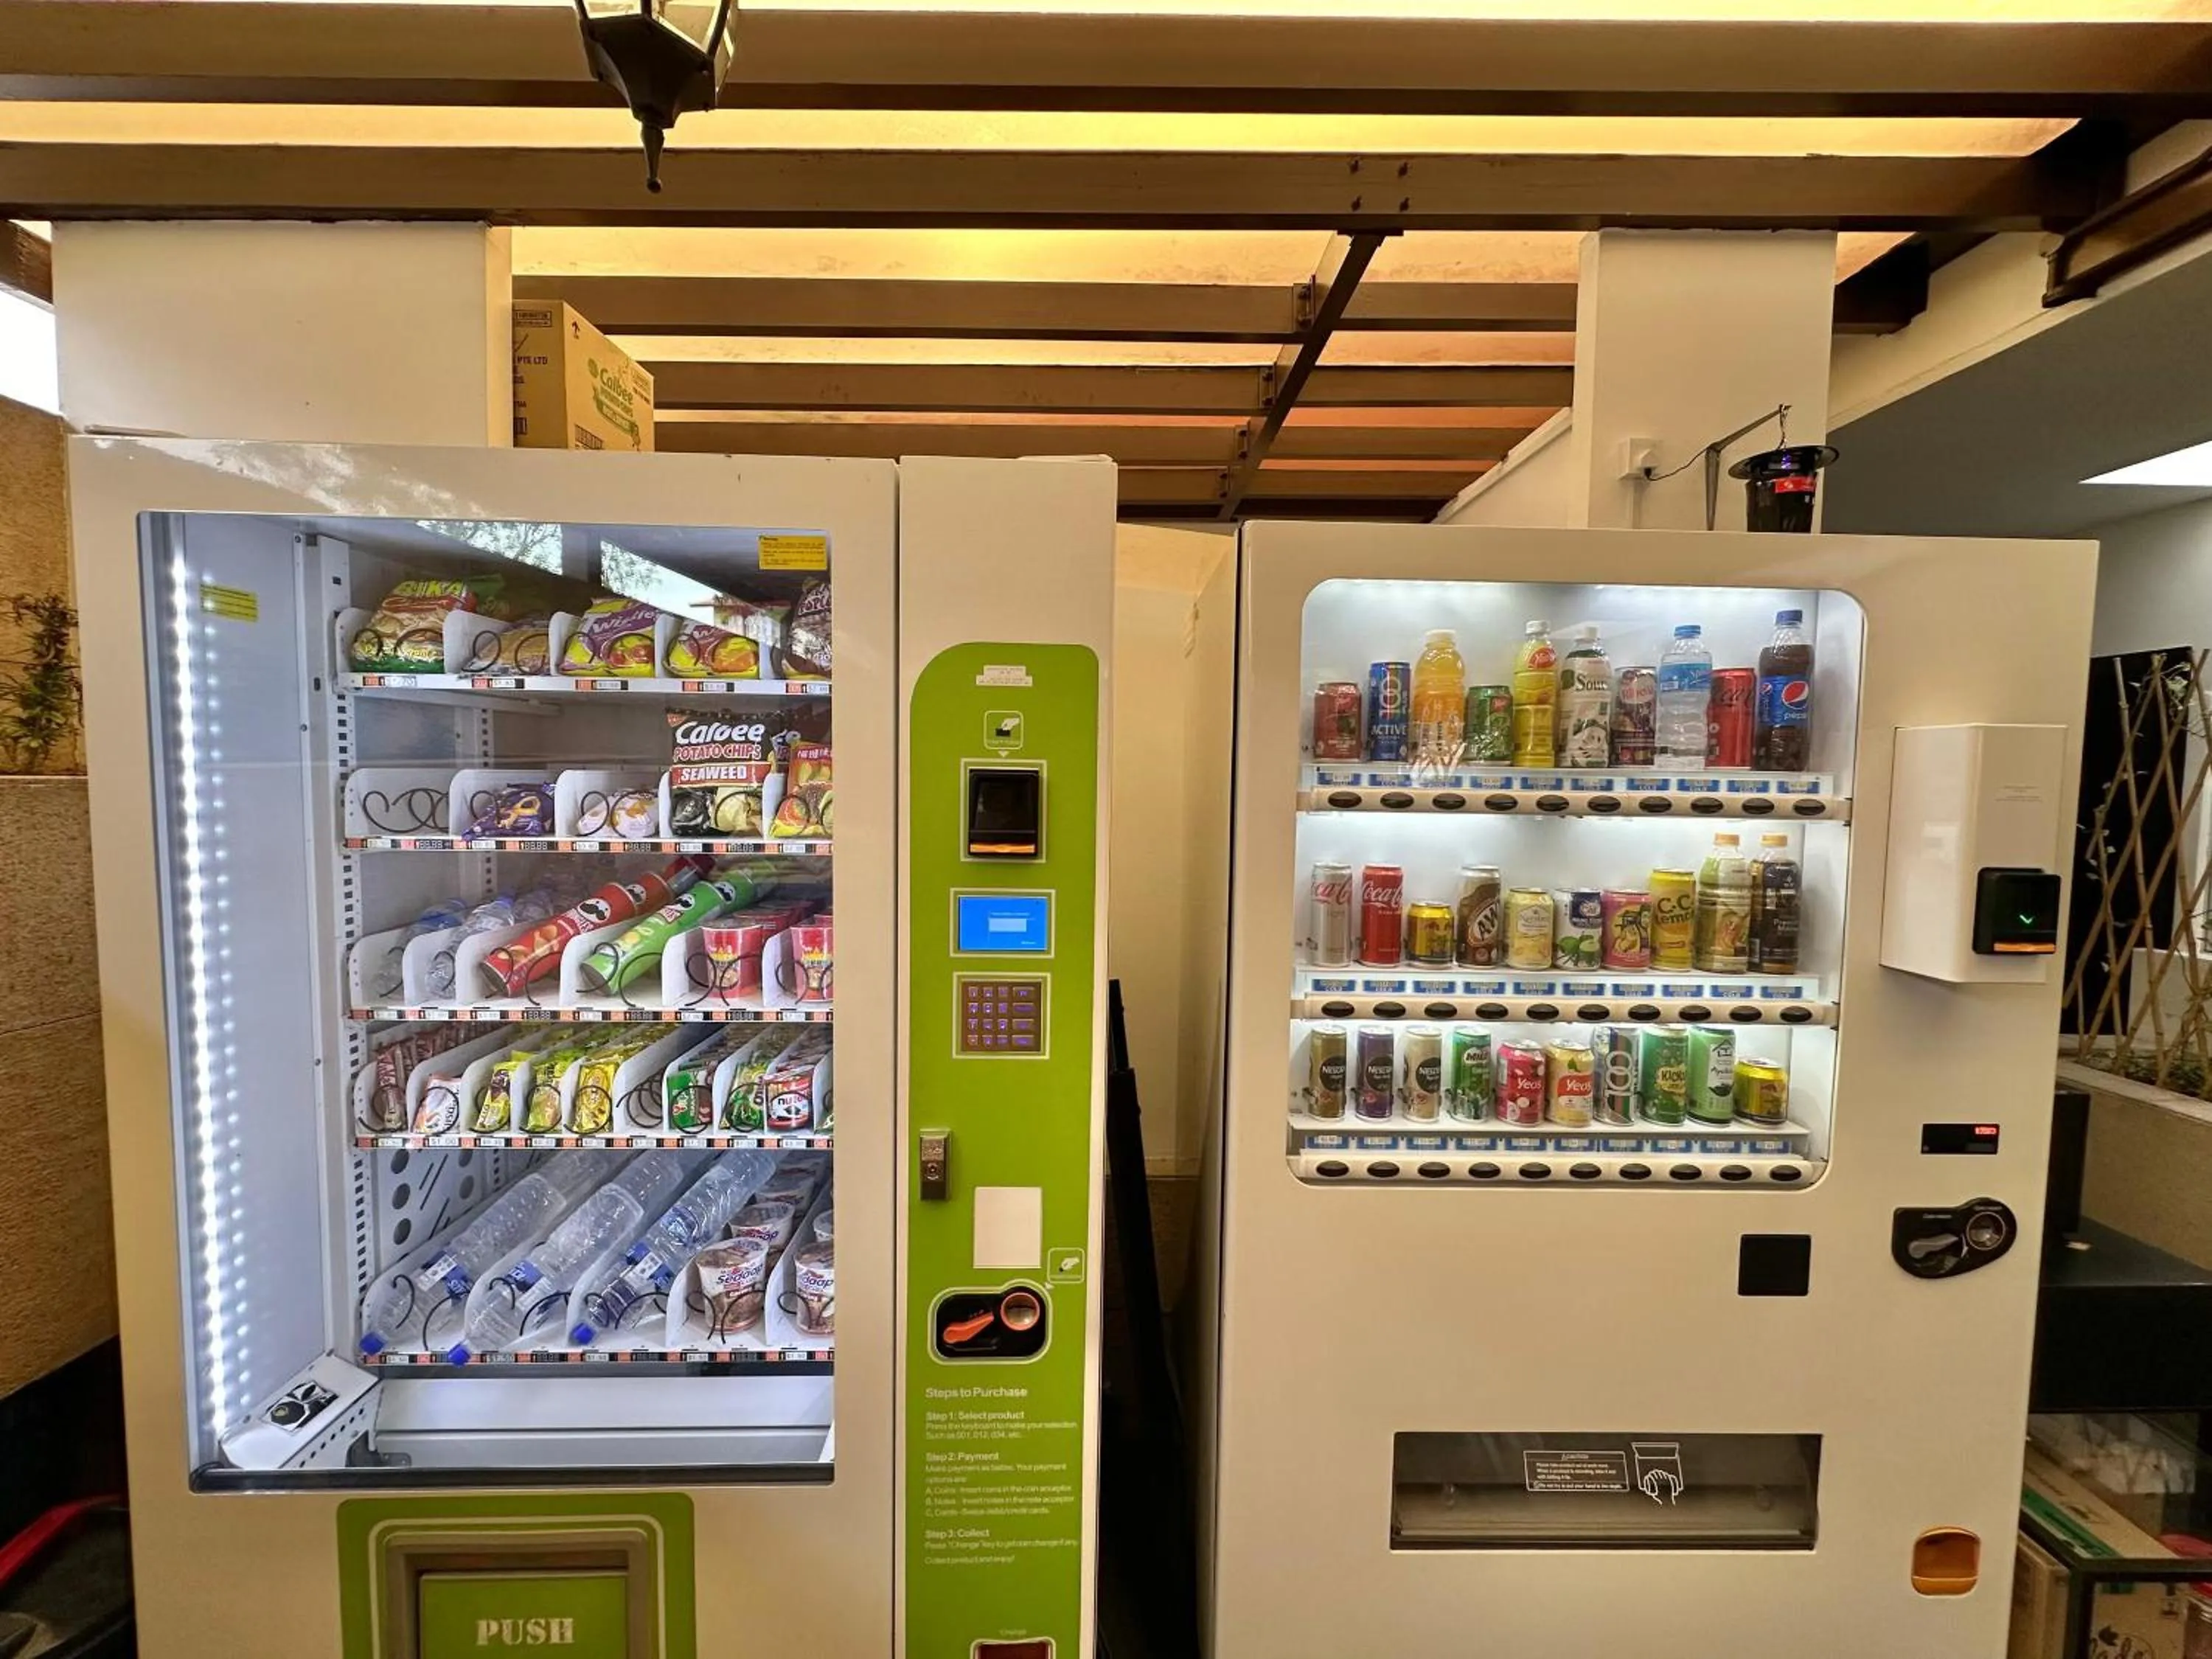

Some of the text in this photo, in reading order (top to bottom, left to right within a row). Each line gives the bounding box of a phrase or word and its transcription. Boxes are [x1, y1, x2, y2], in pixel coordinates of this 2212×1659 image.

[599, 367, 633, 405] Calbee
[675, 720, 765, 745] Calbee
[673, 743, 762, 762] POTATO CHIPS
[681, 765, 748, 782] SEAWEED
[925, 1387, 1028, 1400] Steps to Purchase
[925, 1411, 947, 1422] Step
[959, 1411, 987, 1420] Select
[988, 1411, 1025, 1421] product
[926, 1453, 947, 1463] Step
[958, 1452, 999, 1461] Payment
[925, 1530, 947, 1539] Step
[958, 1528, 990, 1537] Collect
[476, 1618, 574, 1646] PUSH
